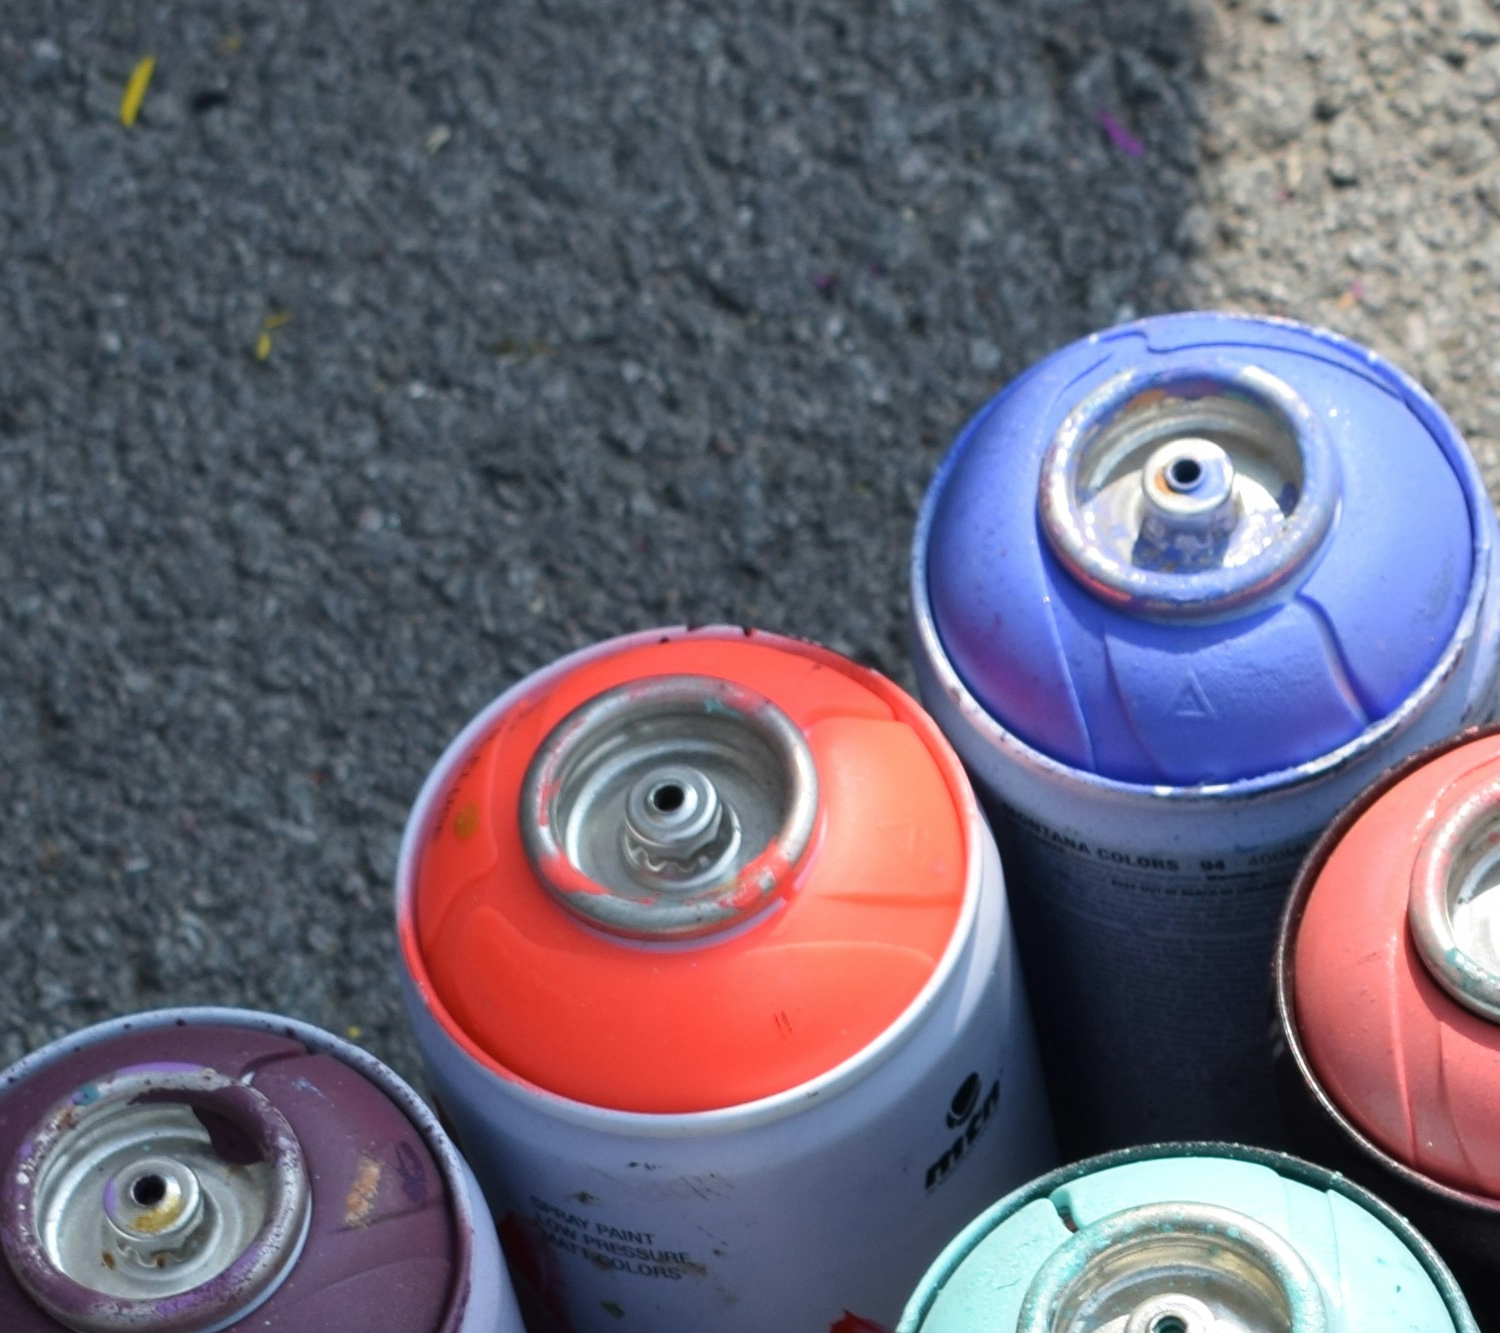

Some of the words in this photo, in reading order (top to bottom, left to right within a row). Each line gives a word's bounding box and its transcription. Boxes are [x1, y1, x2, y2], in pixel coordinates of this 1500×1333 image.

[1097, 847, 1180, 872] COLORS
[596, 1222, 655, 1246] PAINT
[581, 1233, 694, 1267] PRESSURE
